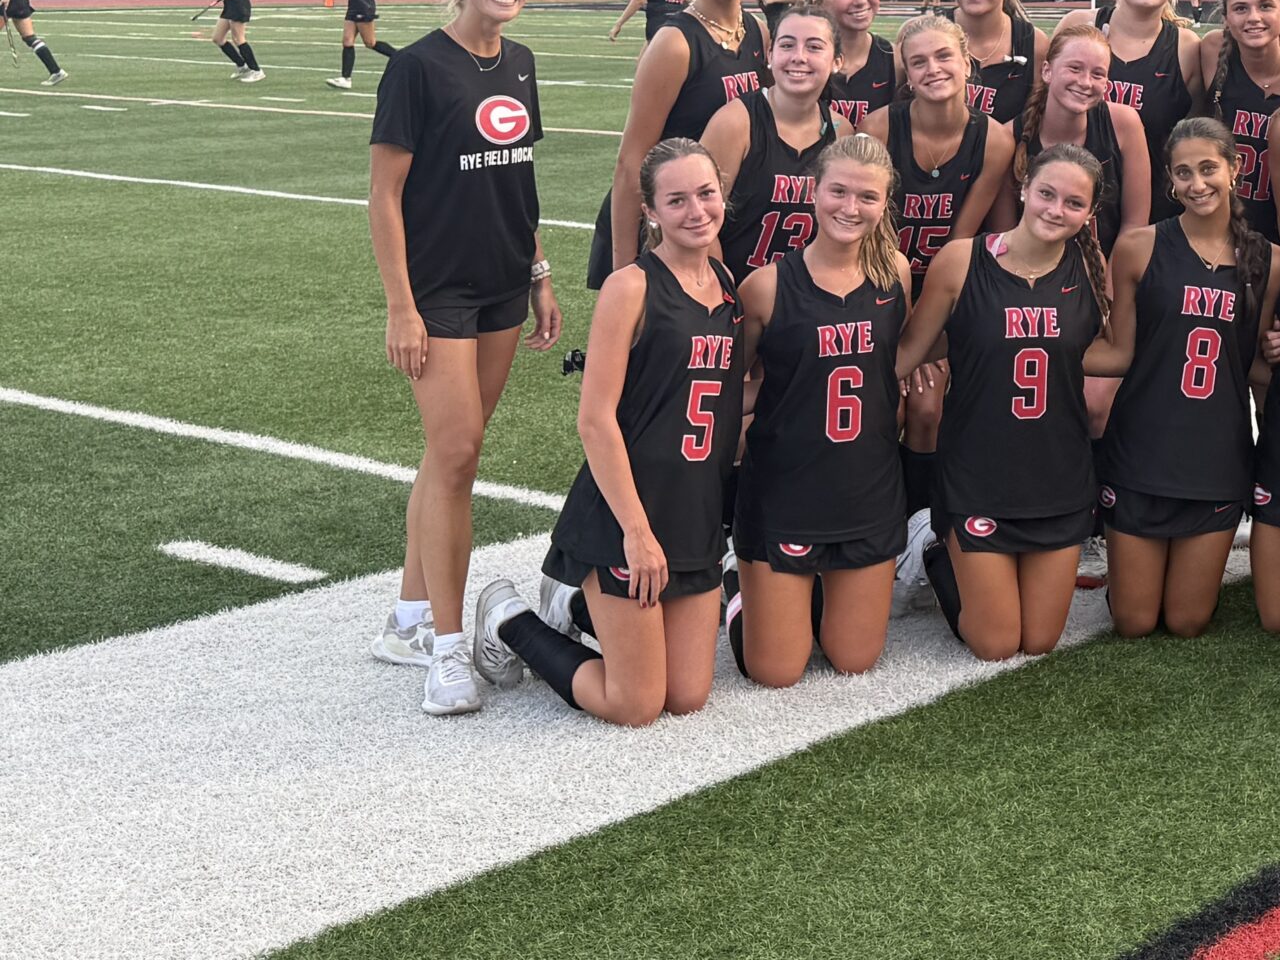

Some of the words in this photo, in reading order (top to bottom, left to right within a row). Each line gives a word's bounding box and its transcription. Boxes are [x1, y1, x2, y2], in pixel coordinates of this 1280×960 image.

[476, 95, 531, 145] G
[1232, 109, 1271, 140] RY
[460, 152, 483, 171] RYE
[484, 149, 510, 167] FIELD
[1235, 144, 1270, 200] 21
[903, 193, 953, 219] RYE
[1004, 306, 1061, 340] RYE
[1181, 285, 1236, 323] RYE
[687, 335, 734, 369] RYE
[817, 320, 875, 358] RYE
[1180, 327, 1222, 400] 8
[1011, 347, 1049, 420] 9
[681, 380, 722, 462] 5
[825, 365, 864, 443] 6
